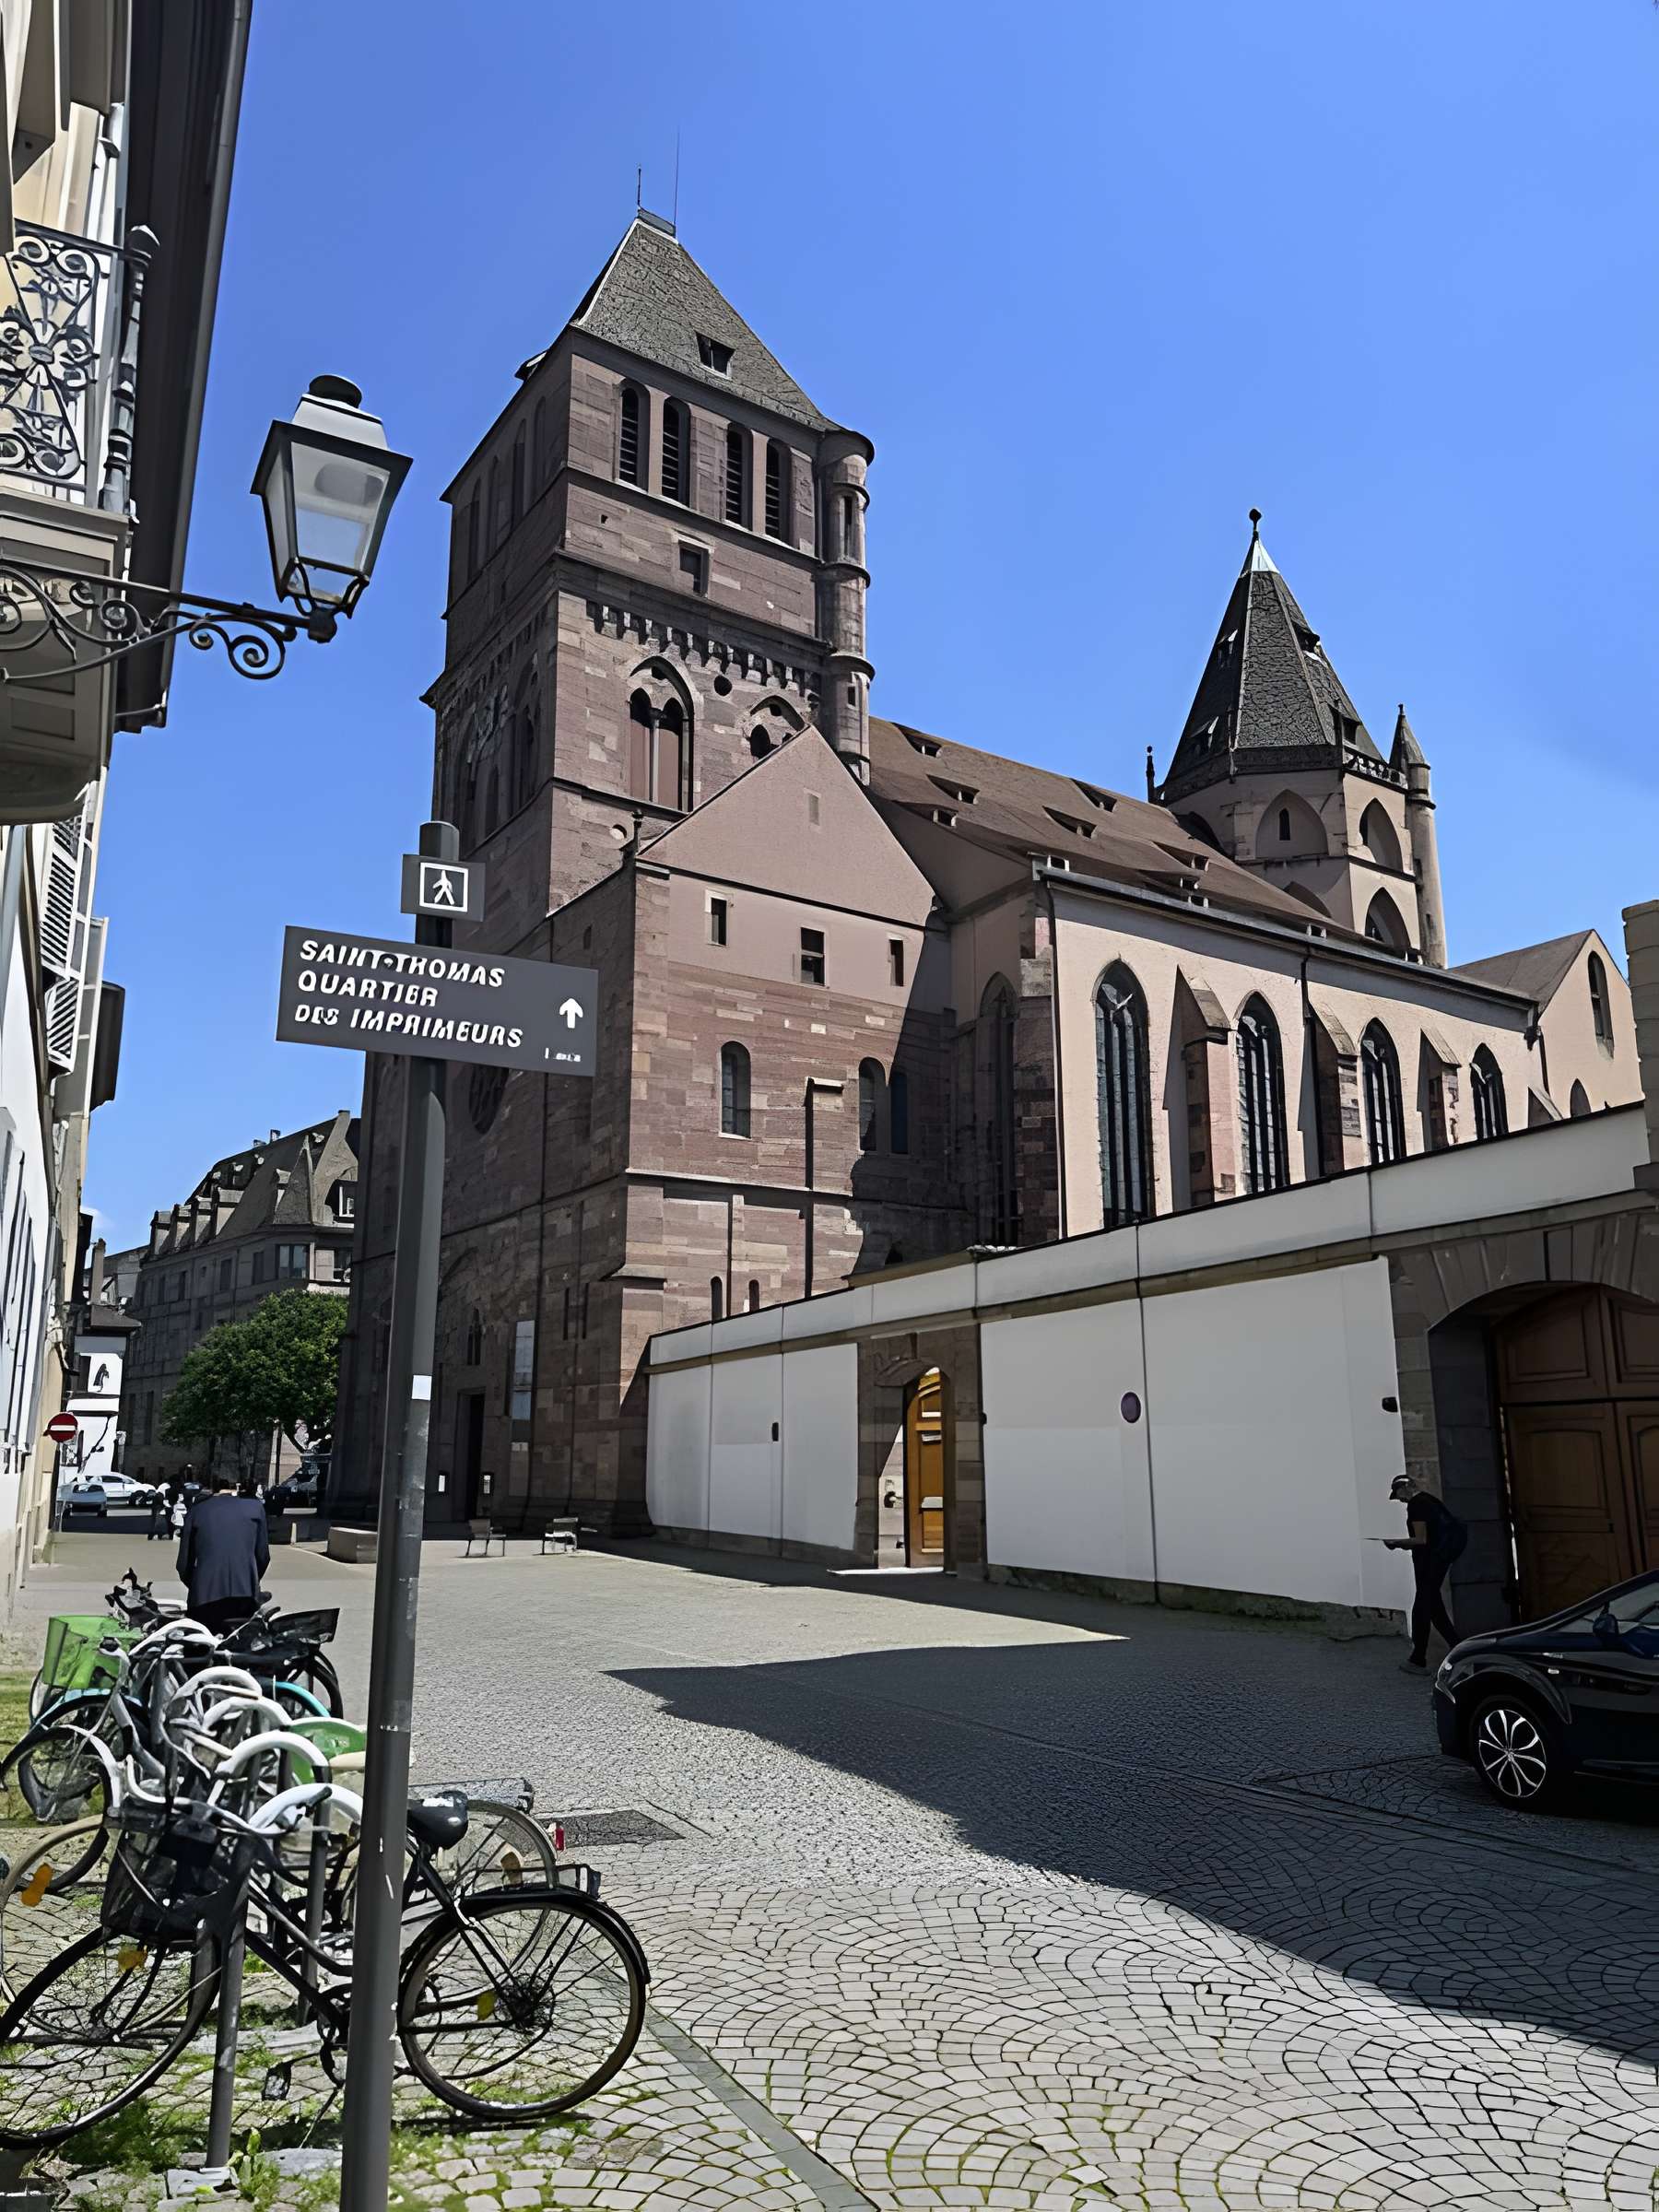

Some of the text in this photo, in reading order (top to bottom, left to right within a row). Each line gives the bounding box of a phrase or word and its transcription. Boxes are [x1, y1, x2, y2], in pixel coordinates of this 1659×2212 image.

[297, 970, 440, 1007] QUARTIER
[294, 1004, 524, 1049] DES IMPRIMEURS
